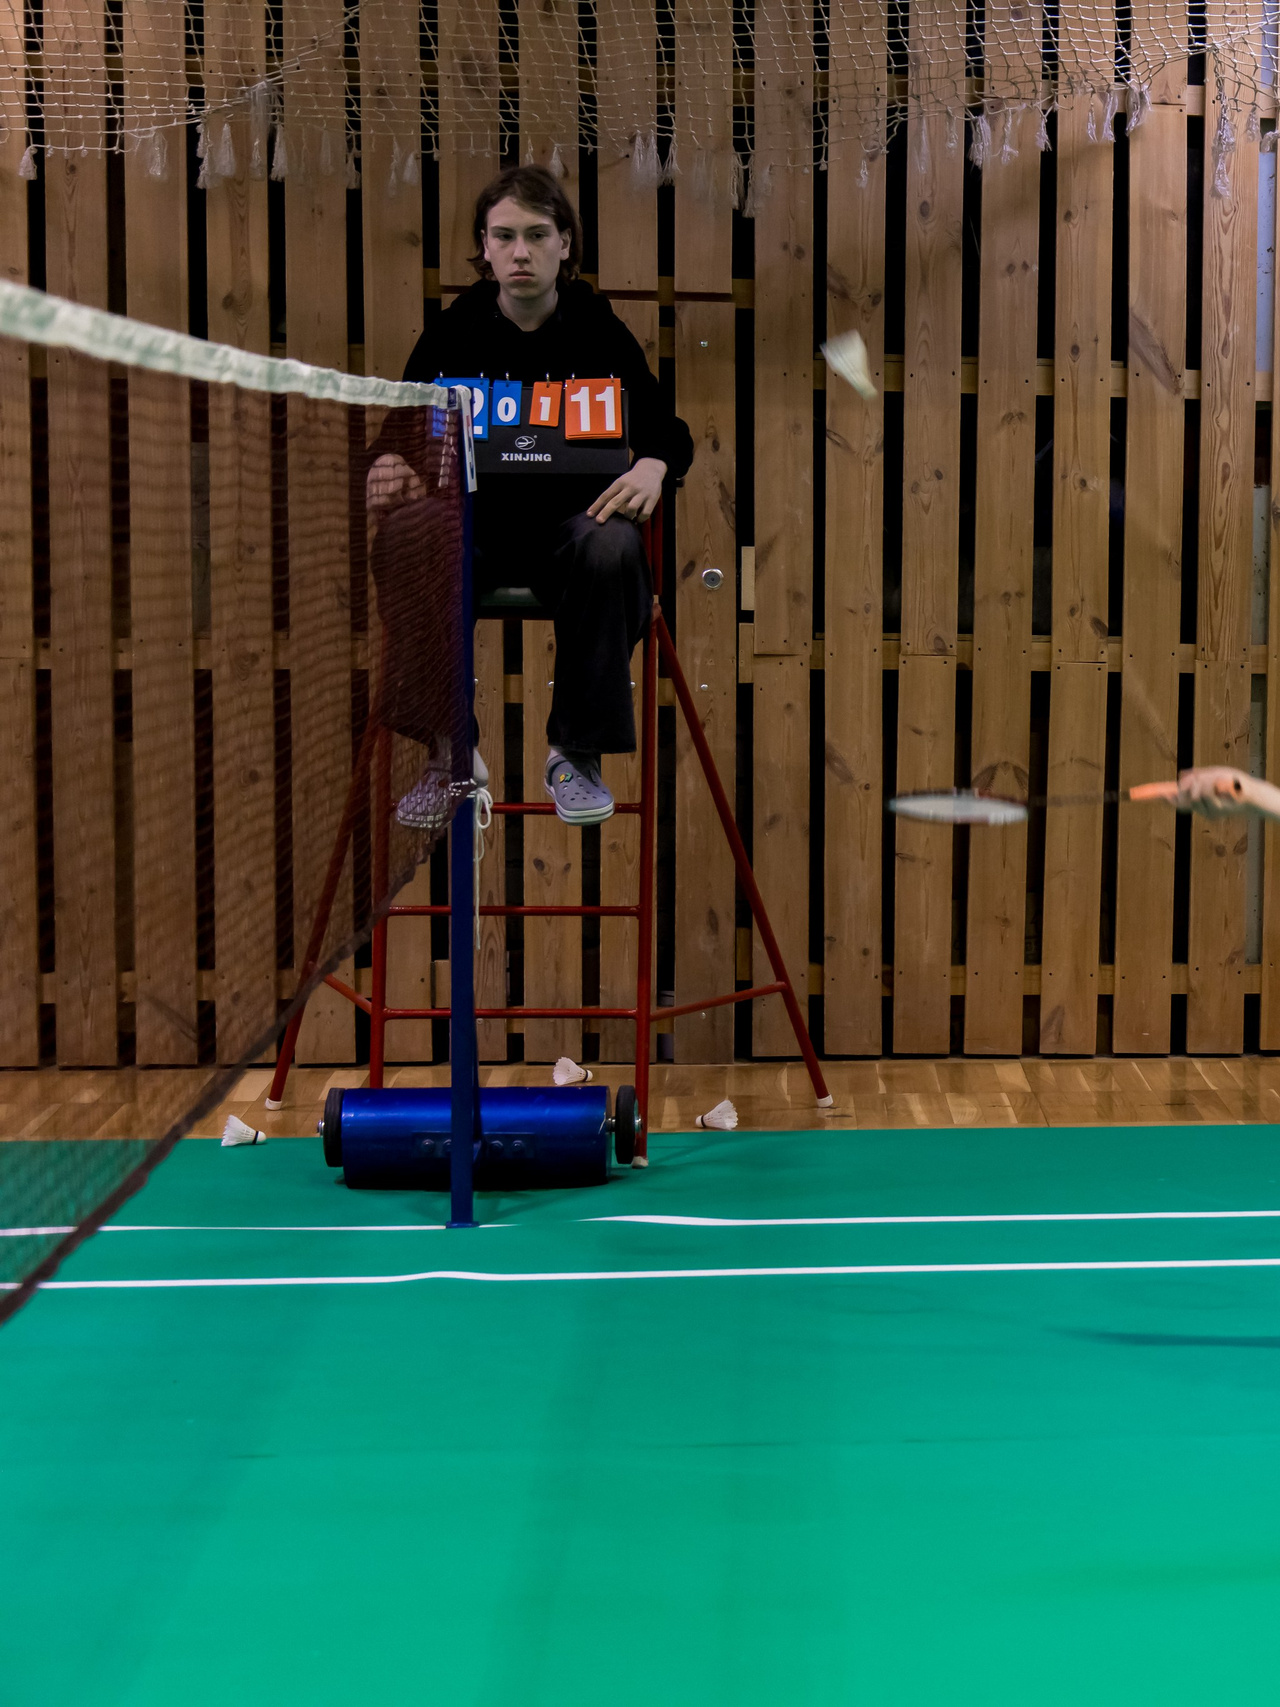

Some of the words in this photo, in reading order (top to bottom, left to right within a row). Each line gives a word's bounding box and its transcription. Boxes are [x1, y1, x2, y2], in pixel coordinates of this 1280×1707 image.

[497, 396, 517, 423] 0
[539, 396, 552, 422] 1
[570, 386, 616, 432] 11
[501, 452, 552, 462] XINJING
